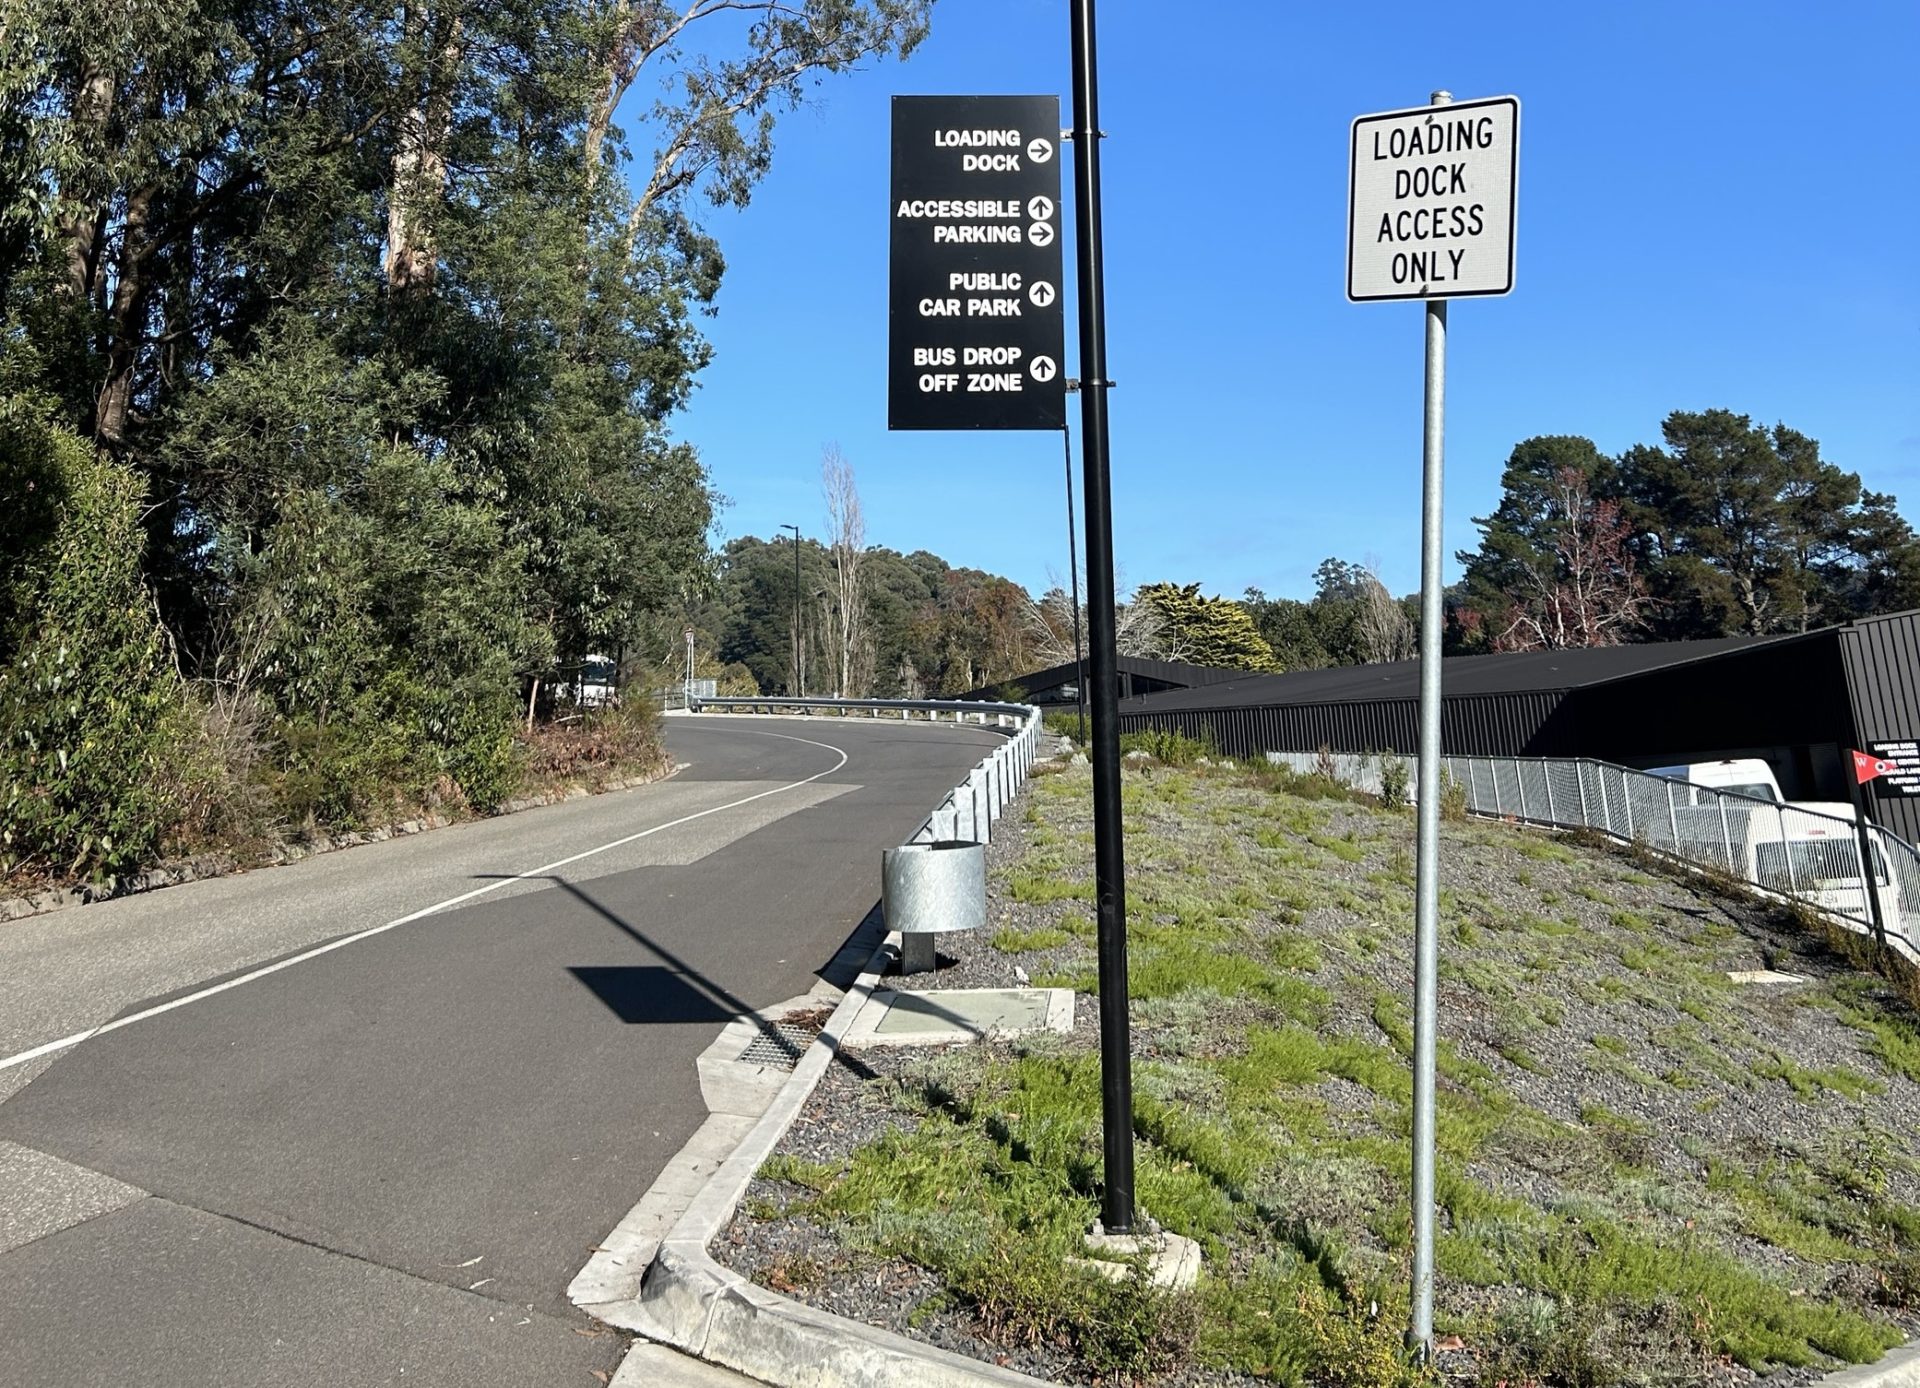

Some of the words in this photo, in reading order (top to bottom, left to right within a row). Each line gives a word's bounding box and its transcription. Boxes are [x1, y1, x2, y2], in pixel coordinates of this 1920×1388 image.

[934, 129, 1021, 147] LOADING
[1374, 117, 1493, 160] LOADING
[962, 154, 1021, 172] DOCK
[1395, 162, 1466, 200] DOCK
[896, 200, 1021, 218] ACCESSIBLE
[1377, 203, 1484, 243] ACCESS
[933, 225, 1022, 243] PARKING
[1391, 248, 1465, 284] ONLY
[949, 272, 1022, 291] PUBLIC
[918, 298, 961, 317] CAR
[967, 298, 1022, 317] PARK
[913, 347, 957, 366] BUS
[963, 347, 1022, 366] DROP
[918, 373, 960, 393] OFF
[966, 373, 1023, 392] ZONE
[1856, 758, 1866, 767] W
